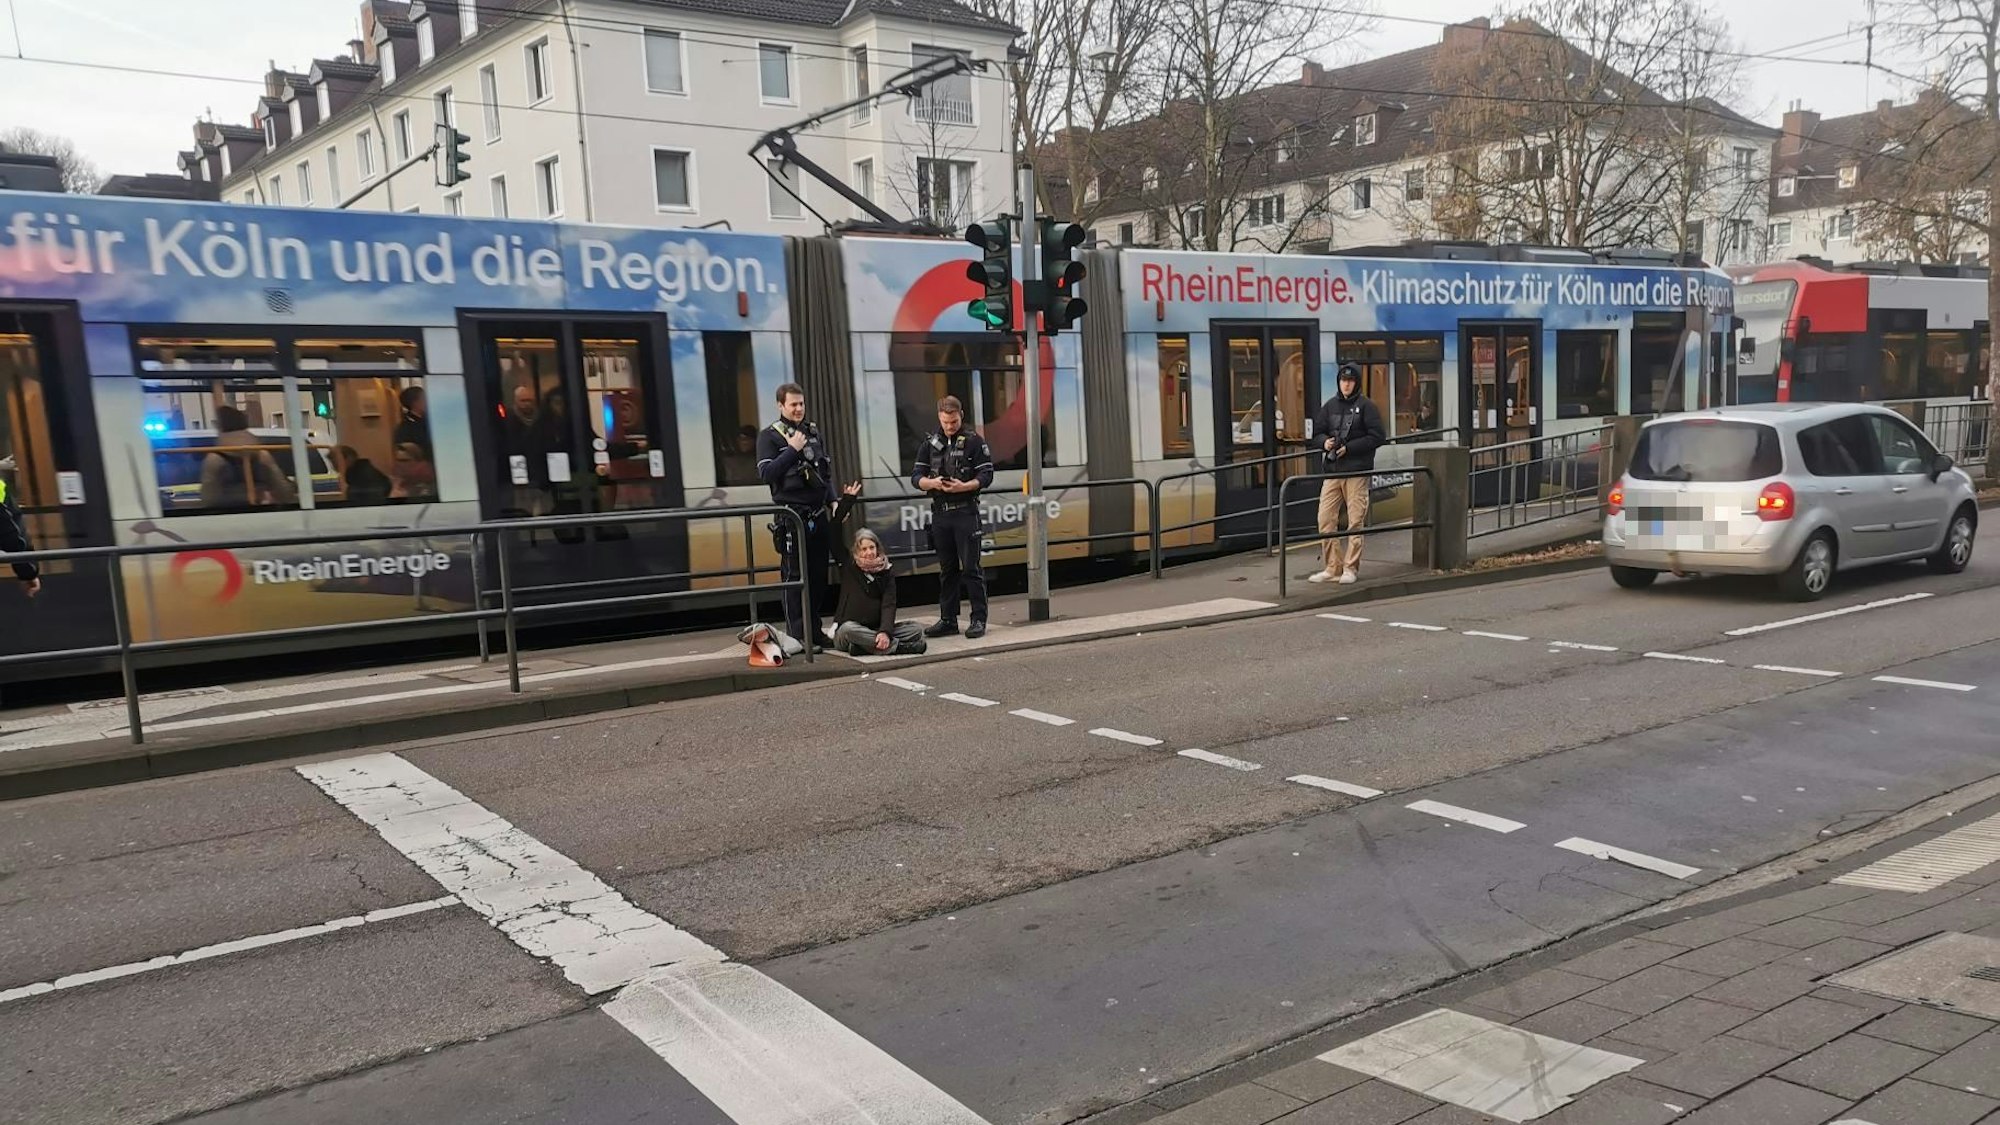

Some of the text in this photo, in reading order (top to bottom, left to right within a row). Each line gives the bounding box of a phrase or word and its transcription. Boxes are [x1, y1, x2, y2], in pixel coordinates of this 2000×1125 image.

[6, 211, 778, 302] für Köln und die Region.
[1142, 263, 1354, 312] RheinEnergie.
[1362, 269, 1516, 305] Klimaschutz
[1520, 273, 1552, 305] für
[1557, 273, 1605, 306] Köln
[1610, 275, 1648, 306] und
[1652, 275, 1683, 307] die
[901, 499, 1061, 532] RhEnere
[253, 549, 451, 584] RheinEnergie
